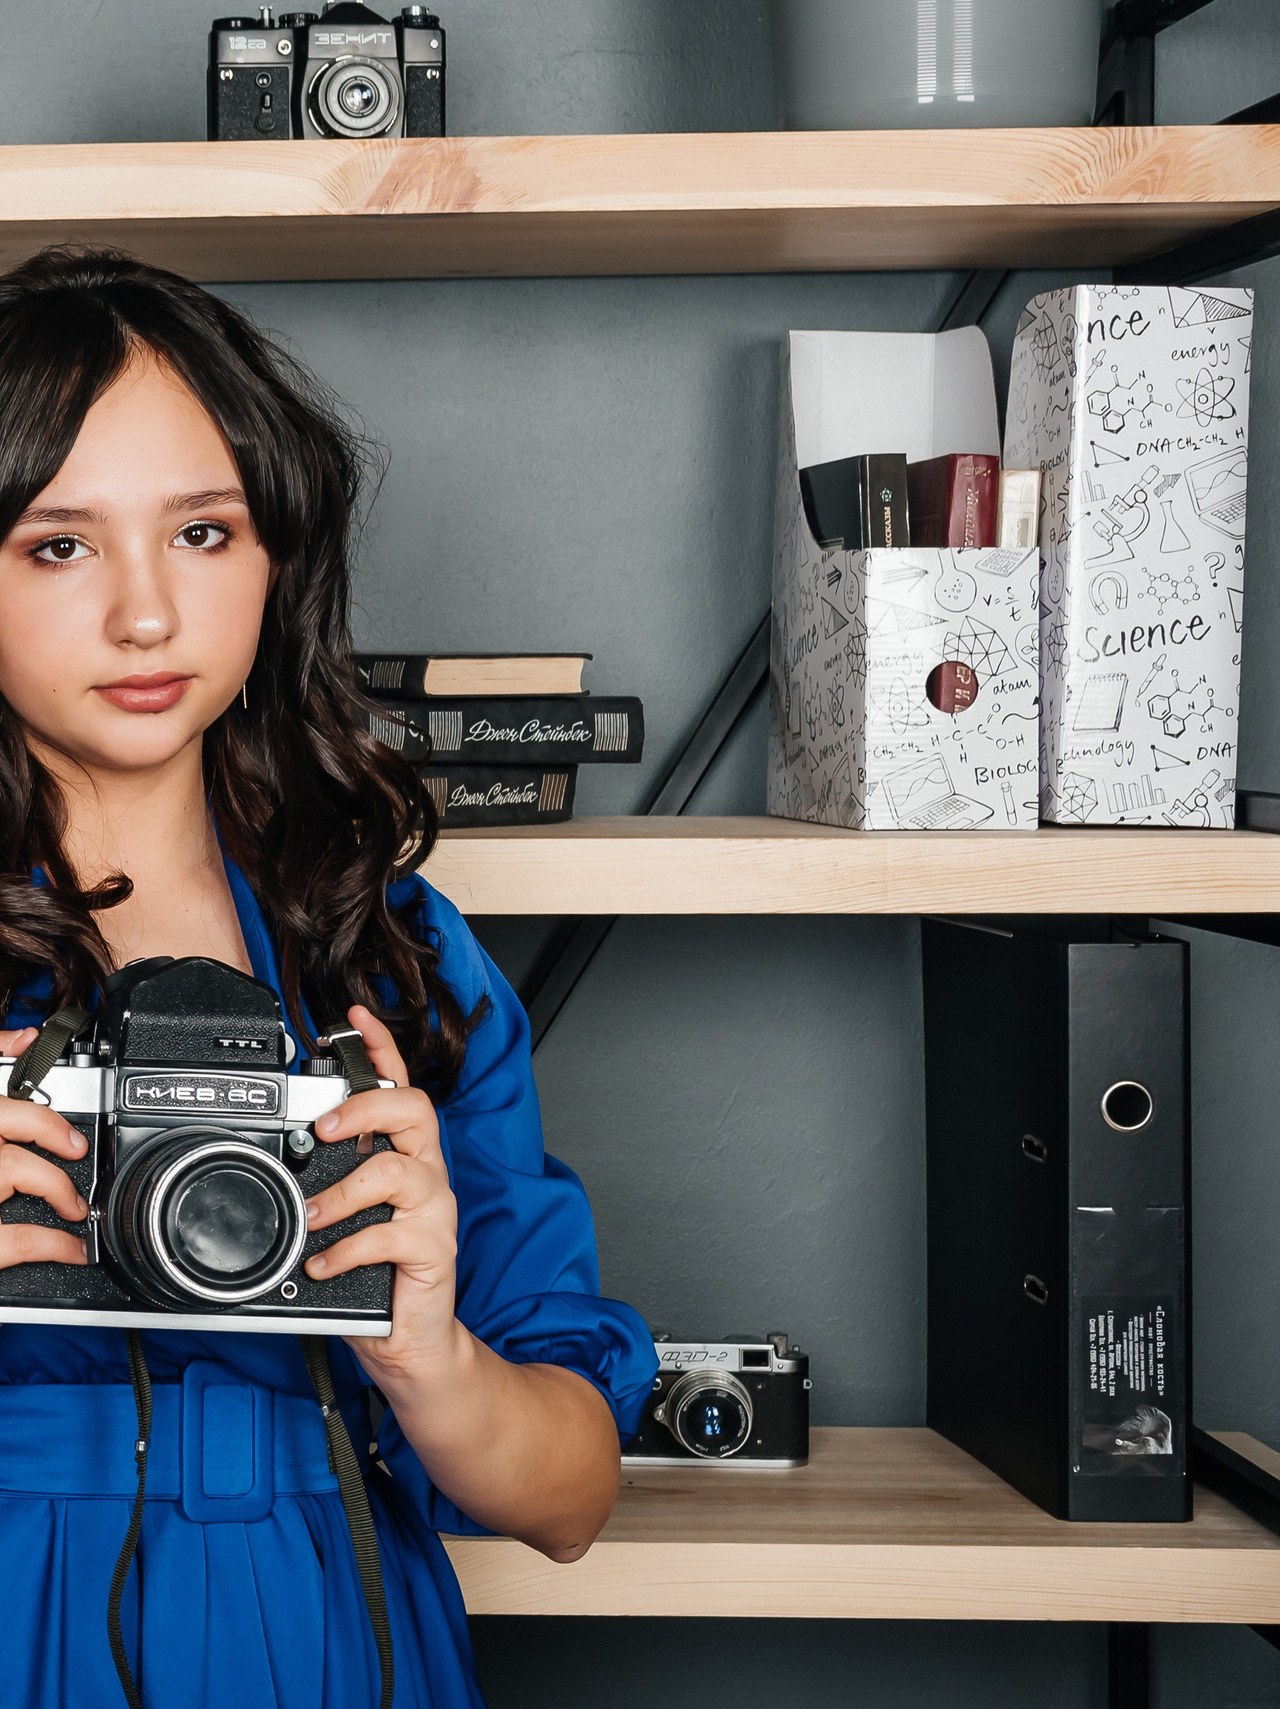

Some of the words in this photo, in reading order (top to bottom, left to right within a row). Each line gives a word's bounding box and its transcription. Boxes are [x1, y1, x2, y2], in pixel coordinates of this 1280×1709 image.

[314, 32, 392, 45] ЗЕНИТ
[1171, 341, 1231, 367] energy
[1077, 614, 1211, 663] Science
[464, 718, 519, 743] Джон
[519, 719, 592, 743] Стейнбек
[447, 784, 486, 808] Джон
[486, 782, 538, 806] Стейнбек
[219, 1039, 262, 1049] TTL
